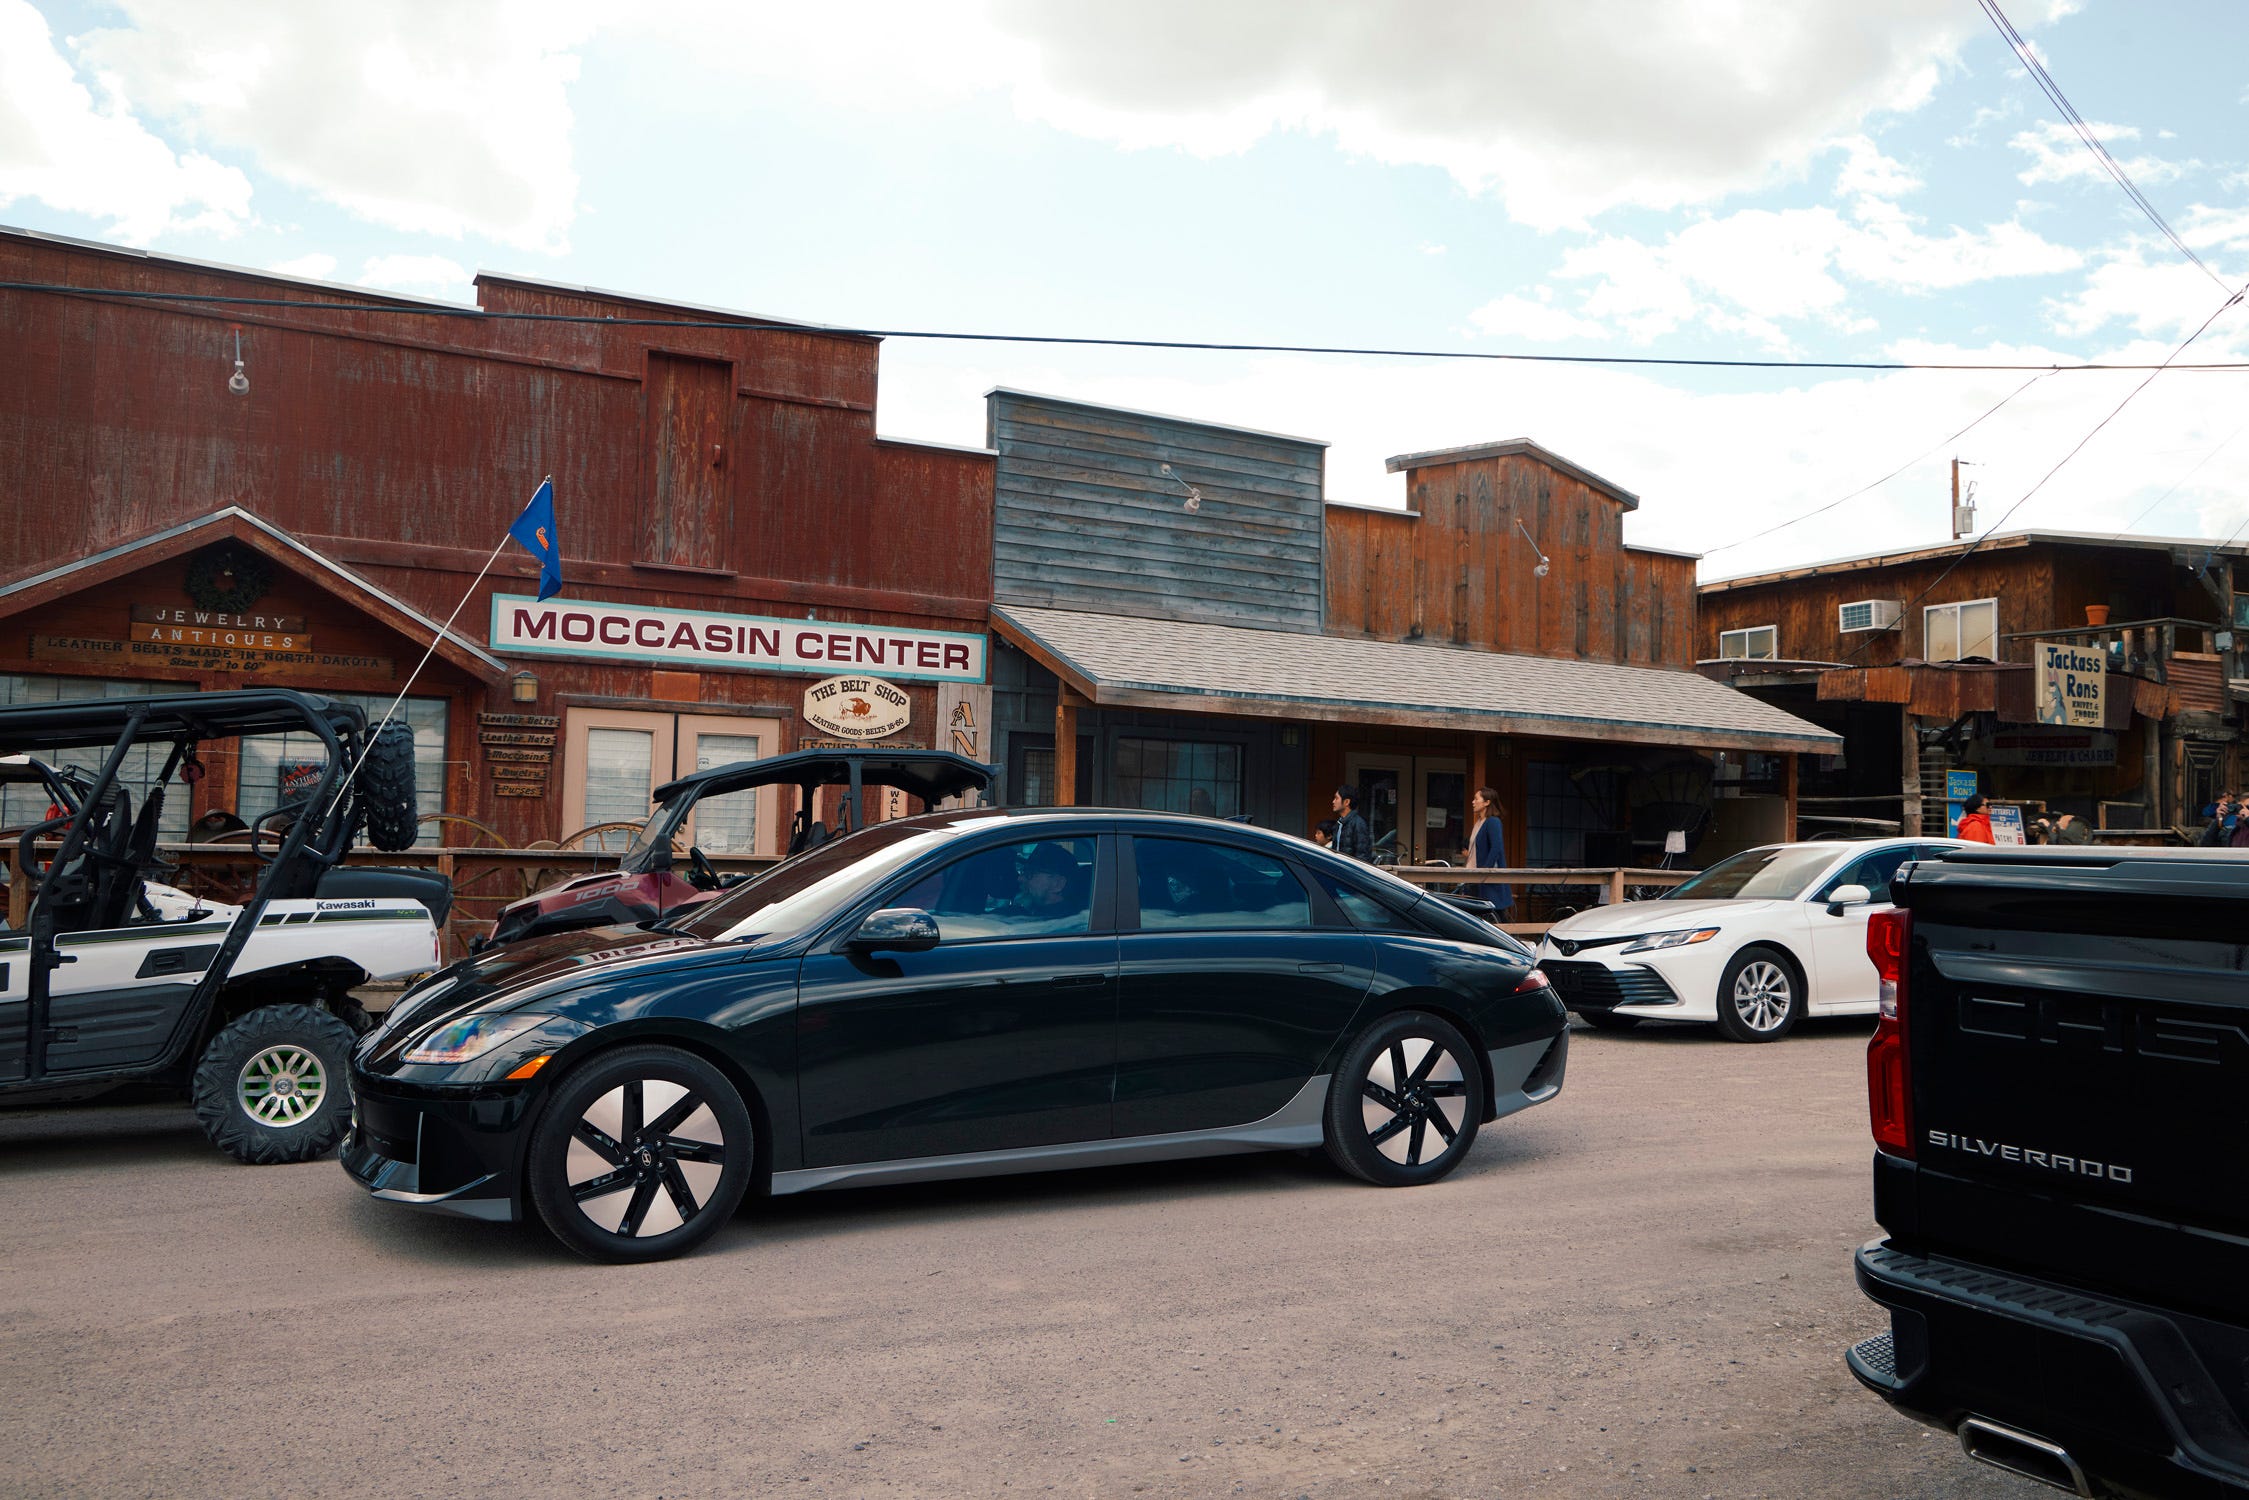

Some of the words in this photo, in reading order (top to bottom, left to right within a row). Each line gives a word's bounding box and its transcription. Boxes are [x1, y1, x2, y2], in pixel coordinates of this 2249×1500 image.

[156, 609, 285, 629] JEWELRY
[151, 628, 293, 648] ANTIQUES
[513, 609, 780, 657] MOCCASIN
[795, 632, 970, 670] CENTER
[48, 638, 123, 651] LEATHER
[132, 643, 182, 656] BELTS
[189, 647, 232, 659] MADE
[240, 651, 257, 660] IN
[264, 652, 314, 664] NORTH
[322, 656, 379, 668] DAKOTA
[2047, 647, 2101, 673] Jackass
[226, 660, 238, 669] to
[811, 683, 837, 702] THE
[840, 680, 870, 692] BELT
[874, 684, 907, 707] SHOP
[2066, 673, 2099, 699] Ron's
[485, 714, 524, 724] Leather
[527, 716, 554, 726] Belts
[812, 713, 840, 733] LEATHER
[485, 732, 524, 742] Leather
[498, 768, 540, 778] Jewelry
[502, 785, 537, 795] Purses
[575, 881, 640, 901] 1000
[316, 900, 375, 910] Kawasaki
[1958, 990, 2249, 1064] CHE
[1928, 1129, 2133, 1184] SILVERADO
